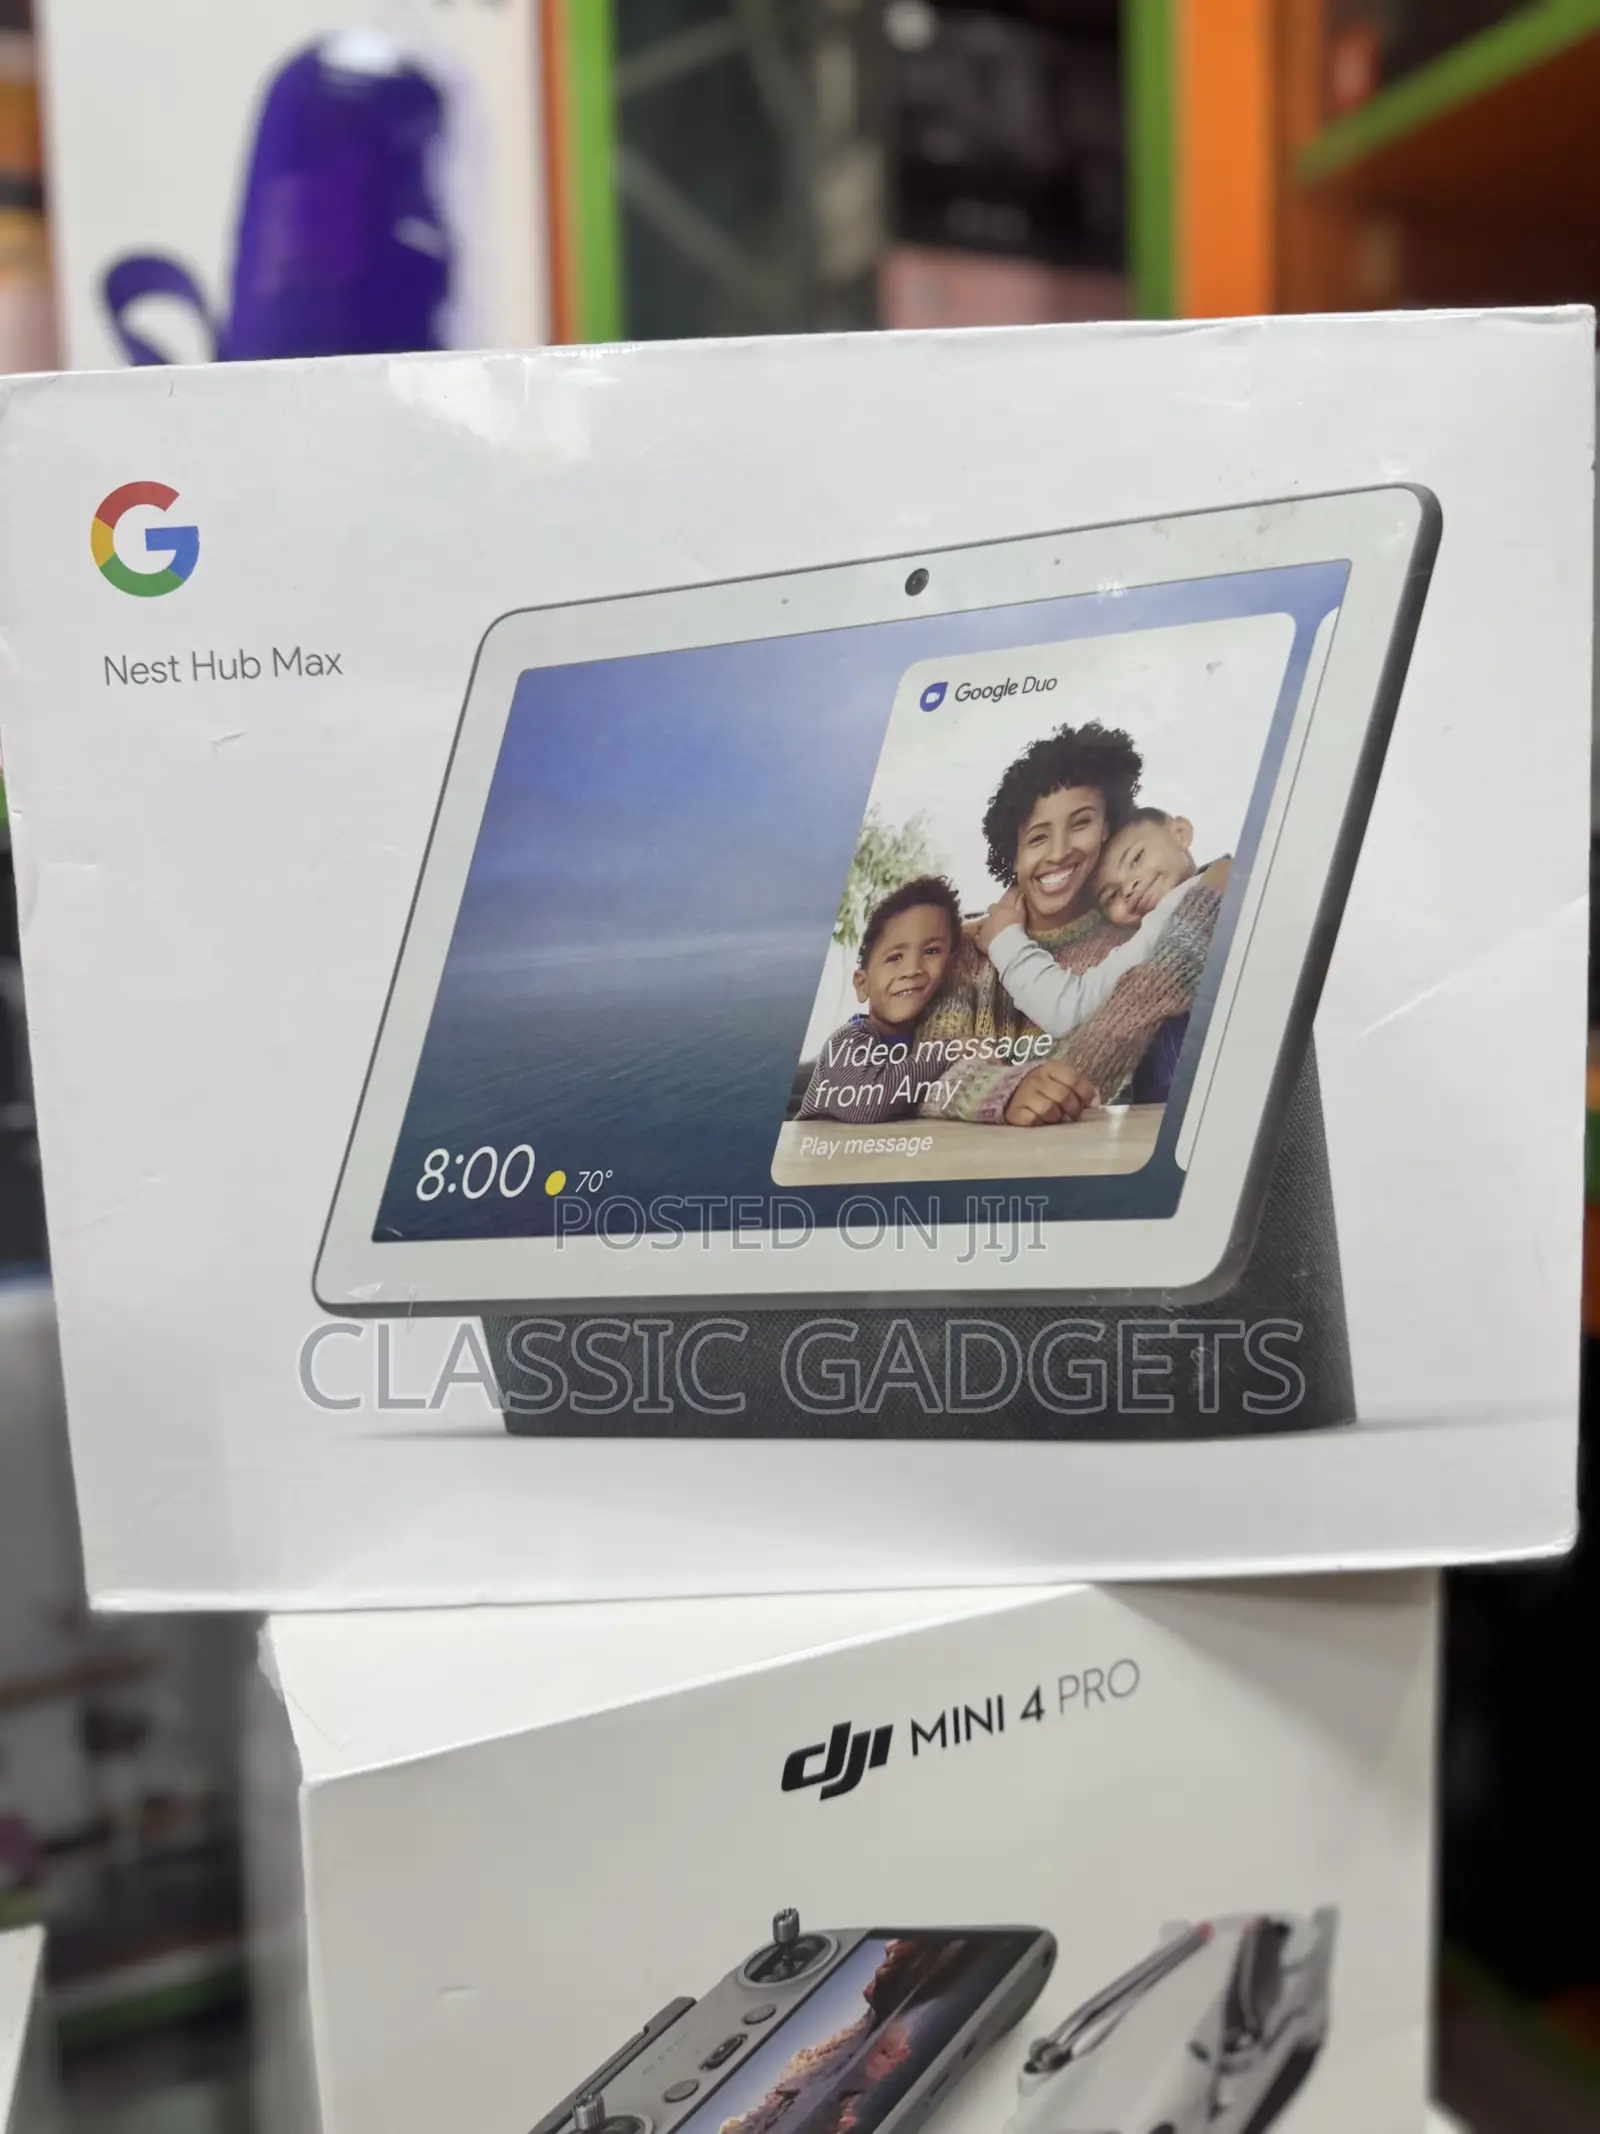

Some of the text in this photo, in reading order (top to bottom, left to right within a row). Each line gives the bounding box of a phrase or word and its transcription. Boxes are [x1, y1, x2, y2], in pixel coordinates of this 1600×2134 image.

[104, 646, 344, 686] Nest Hub Max
[955, 676, 1058, 703] Google Duo
[827, 1032, 1054, 1068] Video message
[813, 1075, 963, 1111] from Amy
[799, 1134, 934, 1160] Play message
[415, 1143, 614, 1202] 8:00 70°
[910, 1693, 1005, 1758] MINI
[1019, 1683, 1046, 1723] 4
[1057, 1658, 1141, 1715] PRO
